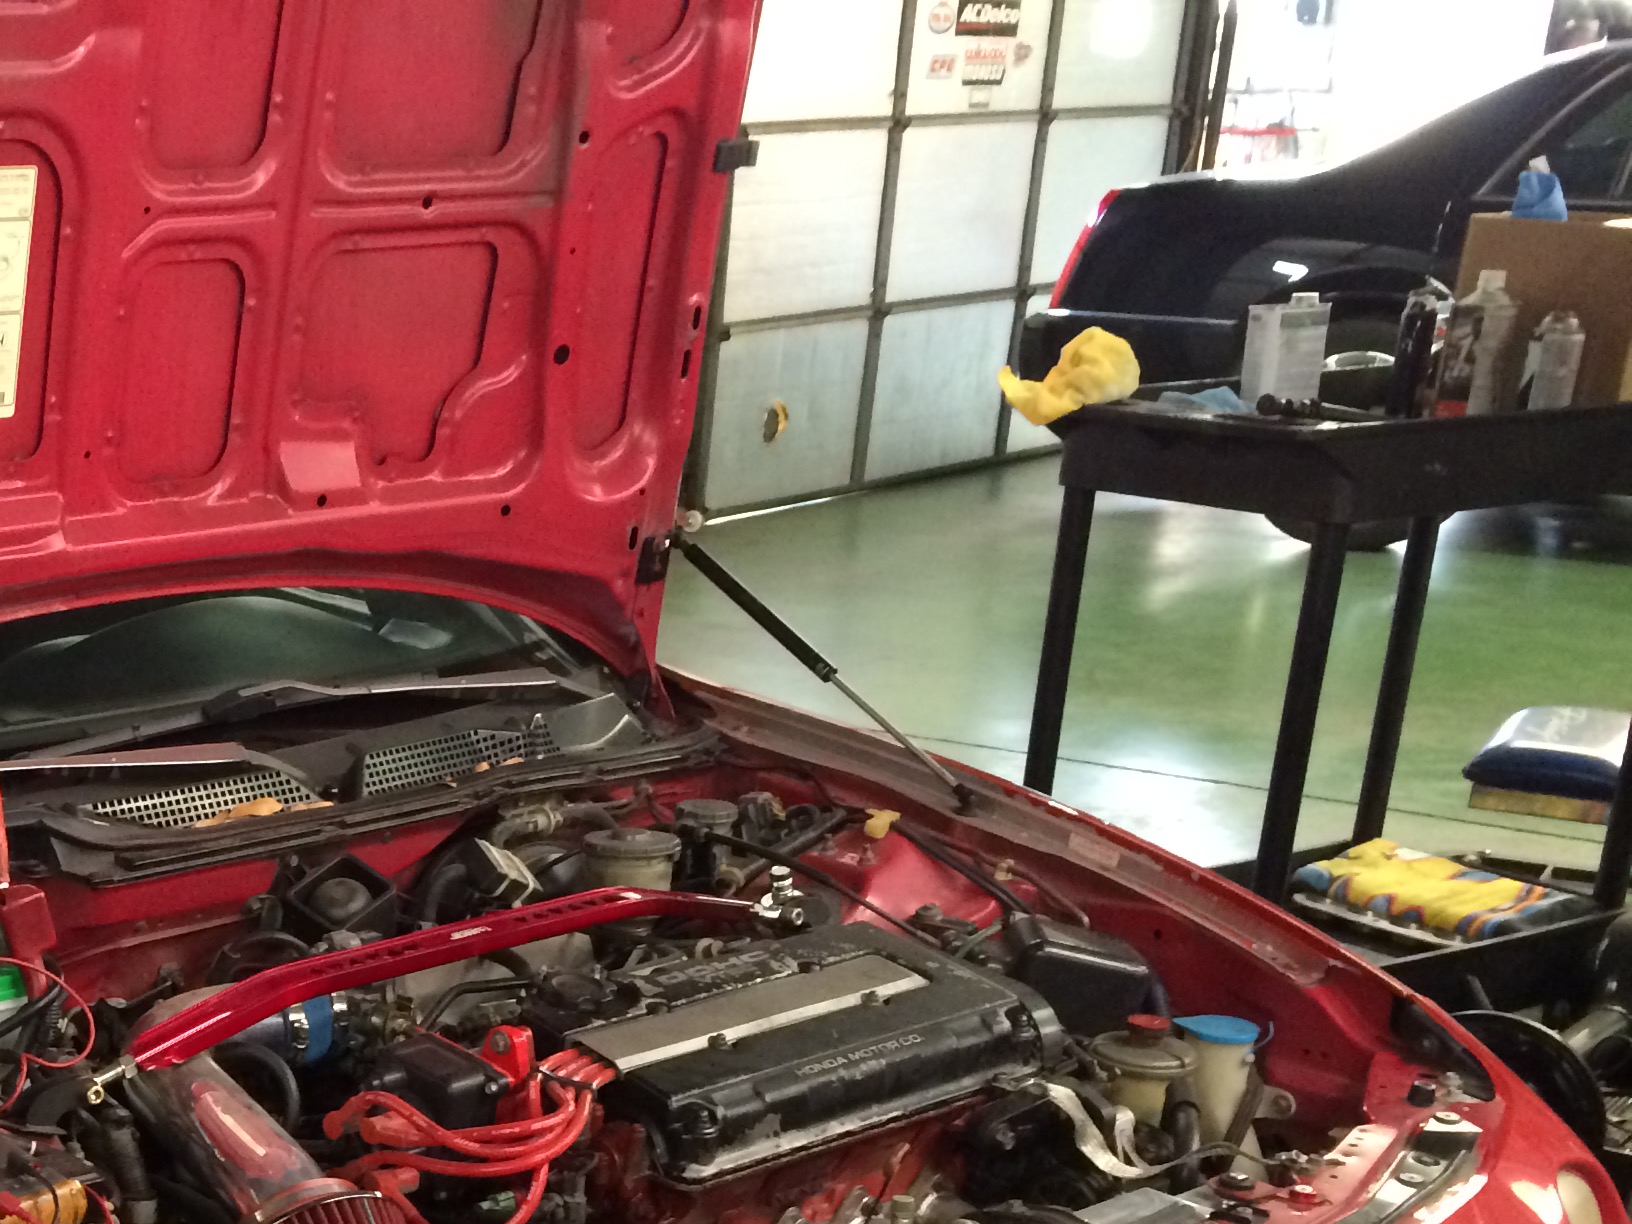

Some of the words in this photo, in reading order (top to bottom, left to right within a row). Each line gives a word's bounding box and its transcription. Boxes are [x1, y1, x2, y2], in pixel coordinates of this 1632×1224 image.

[959, 3, 1020, 24] ACDelco
[794, 1056, 848, 1077] HONDA
[848, 1040, 901, 1061] MOTOR
